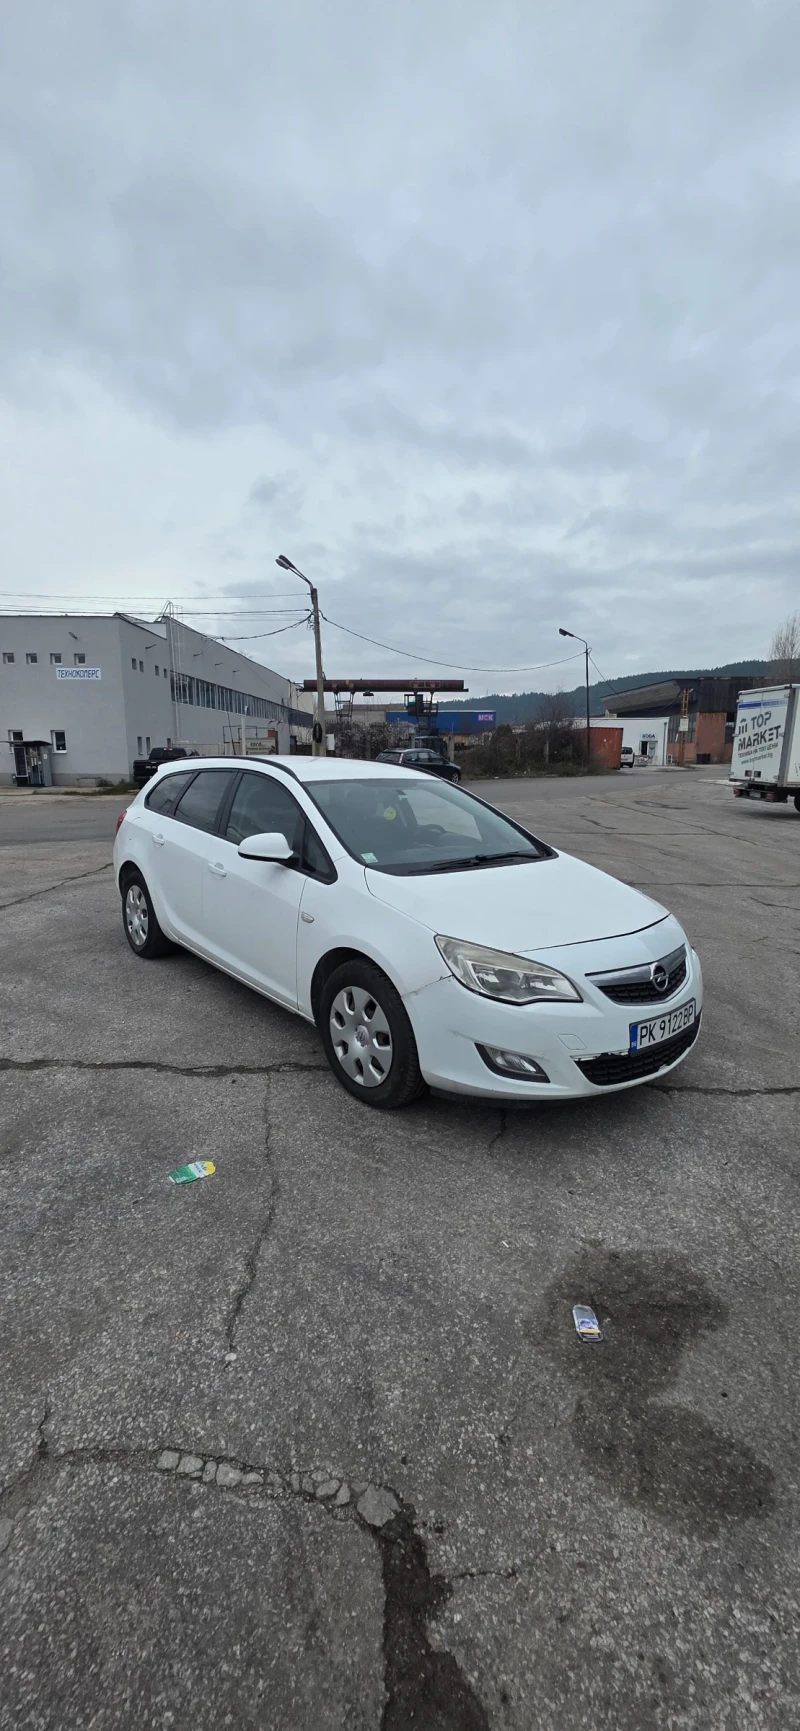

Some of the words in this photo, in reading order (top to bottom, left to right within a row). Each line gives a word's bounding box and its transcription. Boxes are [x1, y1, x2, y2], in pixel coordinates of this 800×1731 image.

[751, 711, 772, 730] TOP
[738, 725, 781, 751] MARKET
[640, 1022, 656, 1045] PK
